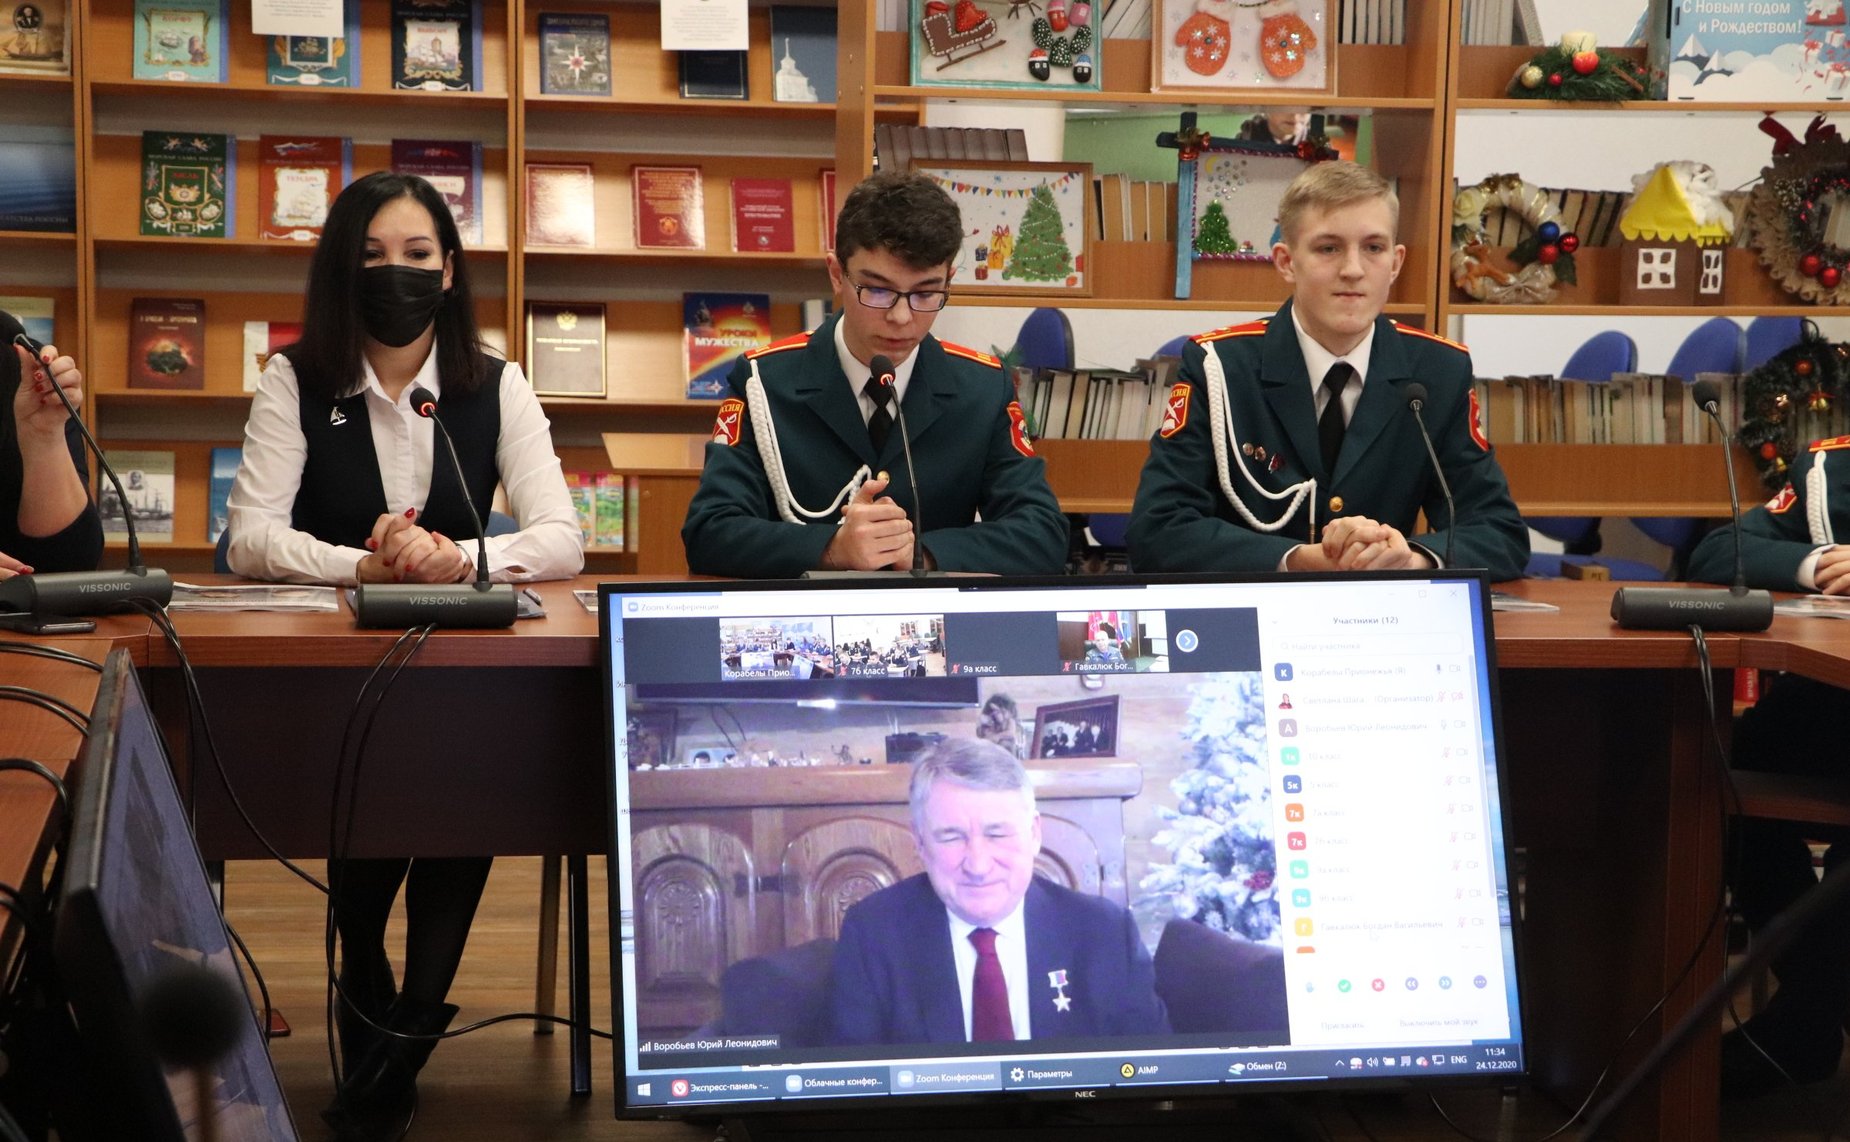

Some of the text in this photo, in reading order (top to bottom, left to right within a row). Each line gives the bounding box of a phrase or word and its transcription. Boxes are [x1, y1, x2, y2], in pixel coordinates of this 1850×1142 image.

[1683, 0, 1791, 16] С Новым годом
[1699, 18, 1802, 35] и Рождеством!
[719, 328, 757, 338] УРОКИ
[694, 336, 759, 348] МУЖЕСТВА
[79, 582, 131, 593] VISSONIC
[409, 595, 468, 606] VISSONIC
[1668, 600, 1725, 610] VISSONIC
[1332, 616, 1399, 625] Участники (12)
[863, 667, 885, 676] класс
[963, 665, 997, 673] 9а класс
[1075, 662, 1113, 671] Гавкалюк
[724, 668, 796, 679] Корабелы Прио...
[653, 1038, 778, 1051] Воробьев Юрий Леонидович
[1485, 1047, 1506, 1056] 11:34
[1451, 1055, 1468, 1064] ENG
[1137, 1065, 1159, 1075] AIMP
[1246, 1062, 1273, 1072] Обмен
[1476, 1060, 1518, 1070] 24.12.2020
[915, 1071, 995, 1083] Zoom Конференция
[1027, 1068, 1073, 1080] Параметры
[804, 1076, 883, 1088] Облачные конфер...
[690, 1082, 758, 1093] Экспресс-панель
[1074, 1089, 1097, 1098] NEC
